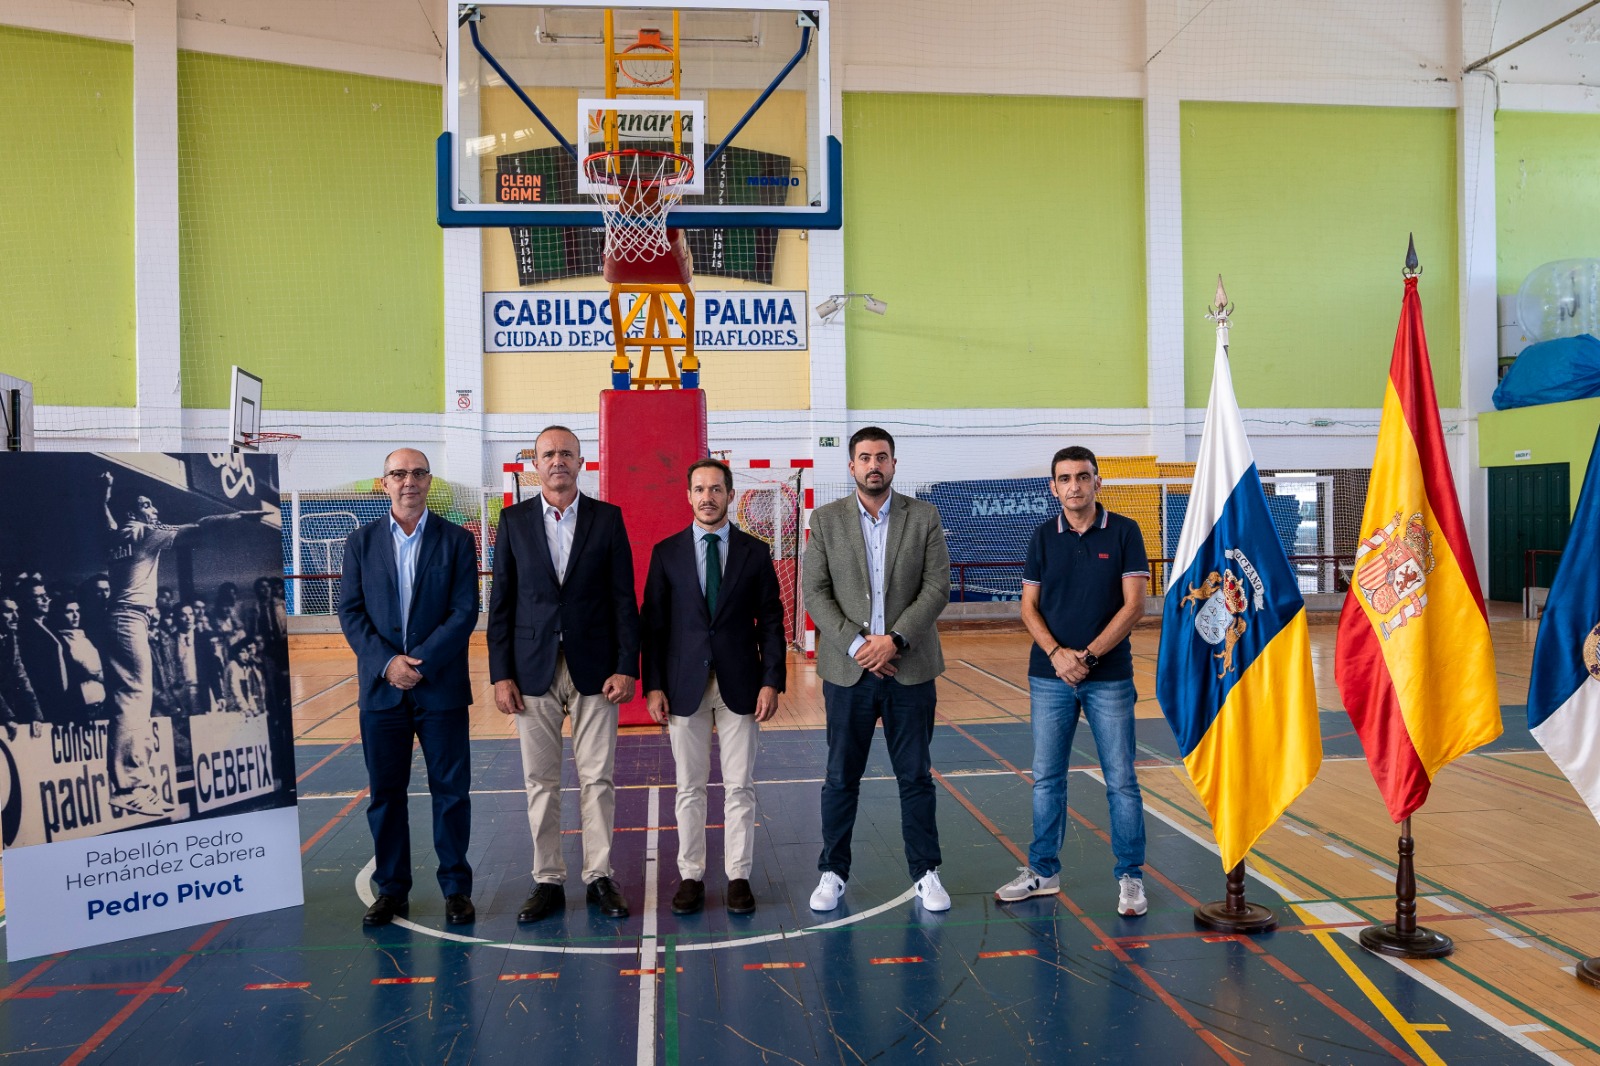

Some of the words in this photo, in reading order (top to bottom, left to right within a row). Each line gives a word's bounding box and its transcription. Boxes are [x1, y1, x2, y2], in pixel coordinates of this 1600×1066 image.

[501, 174, 541, 187] CLEAN
[501, 188, 541, 201] GAME
[747, 176, 800, 187] MONDO
[705, 298, 797, 325] PALMA
[494, 330, 562, 347] CIUDAD
[682, 330, 798, 346] IRAFLORES
[1236, 553, 1262, 590] OCEANO
[196, 744, 272, 803] CEBEFIX
[86, 840, 178, 868] Pabellón
[185, 830, 243, 851] Pedro
[66, 859, 184, 891] Hernández
[189, 846, 266, 869] Cabrera
[87, 891, 169, 920] Pedro
[177, 874, 244, 904] Pivot
